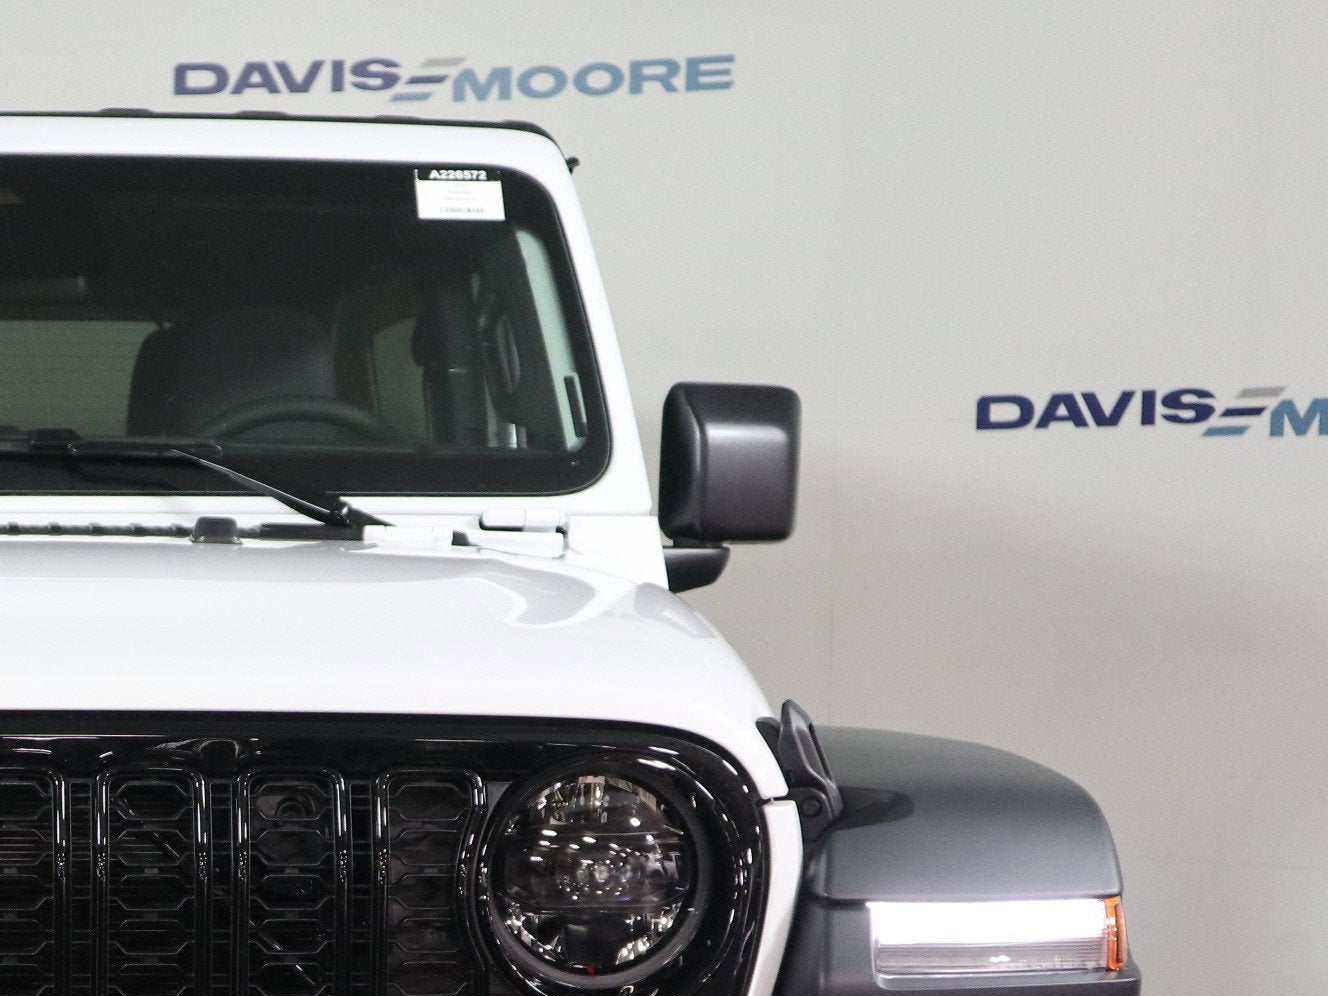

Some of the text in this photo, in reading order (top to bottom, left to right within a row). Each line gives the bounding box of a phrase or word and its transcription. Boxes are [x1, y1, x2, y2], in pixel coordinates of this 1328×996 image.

[172, 53, 736, 102] DAVIS MOORE
[429, 169, 488, 180] A226572
[976, 388, 1217, 430] DAVIS
